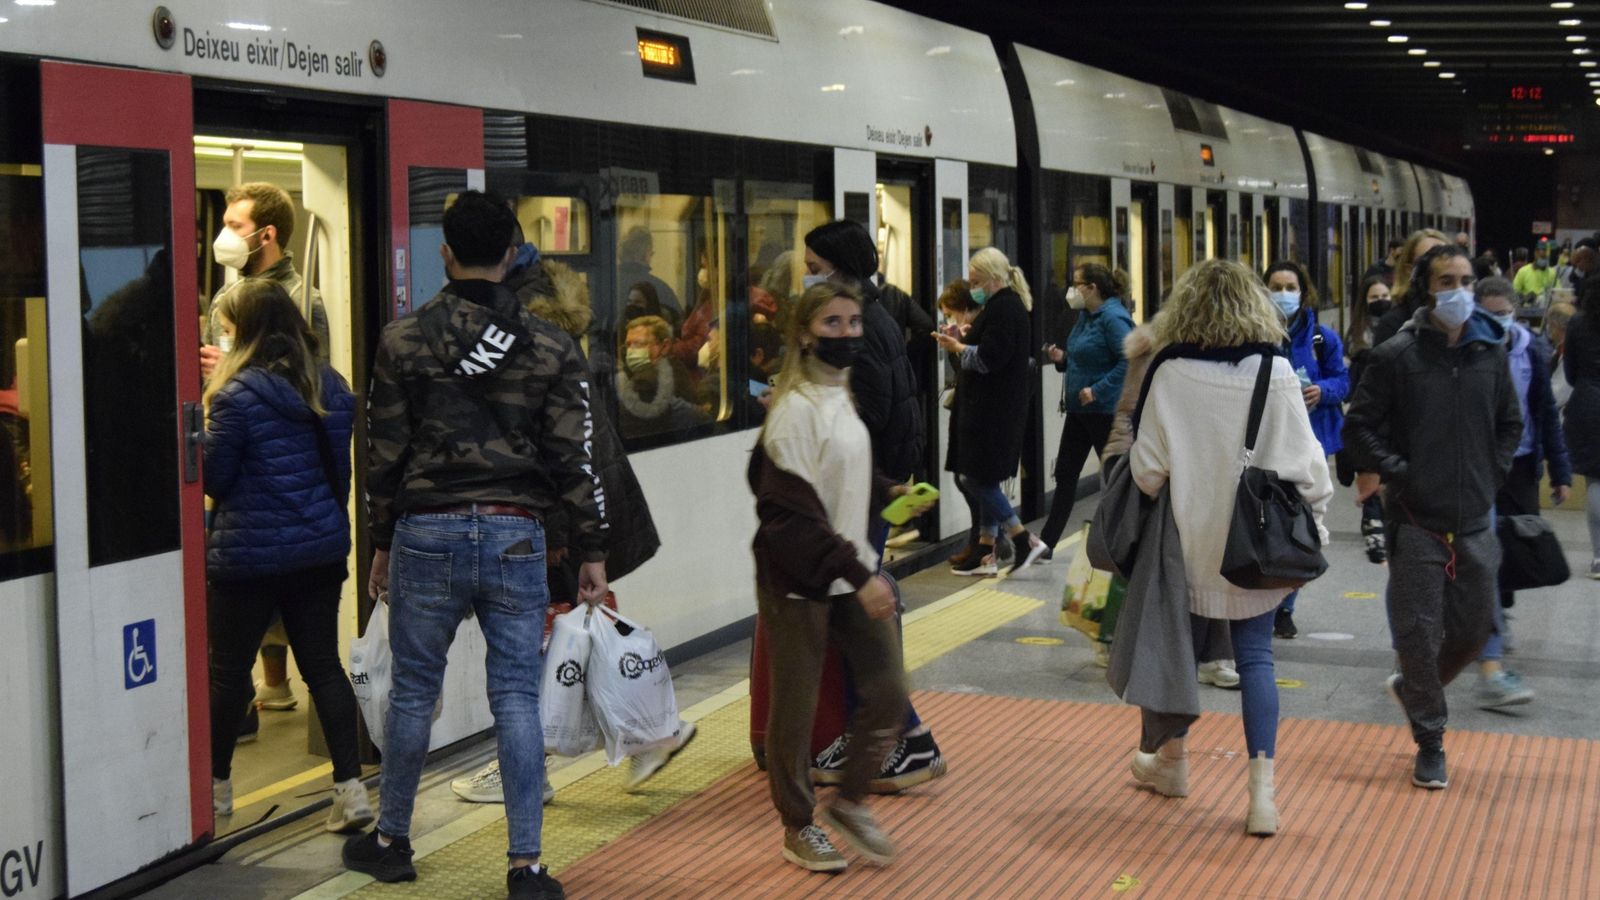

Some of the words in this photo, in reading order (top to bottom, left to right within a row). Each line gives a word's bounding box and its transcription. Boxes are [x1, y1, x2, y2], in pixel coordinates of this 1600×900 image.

[183, 27, 240, 62] Deixeu
[335, 51, 364, 78] salir
[453, 323, 517, 376] AKE
[1, 840, 44, 897] GV
